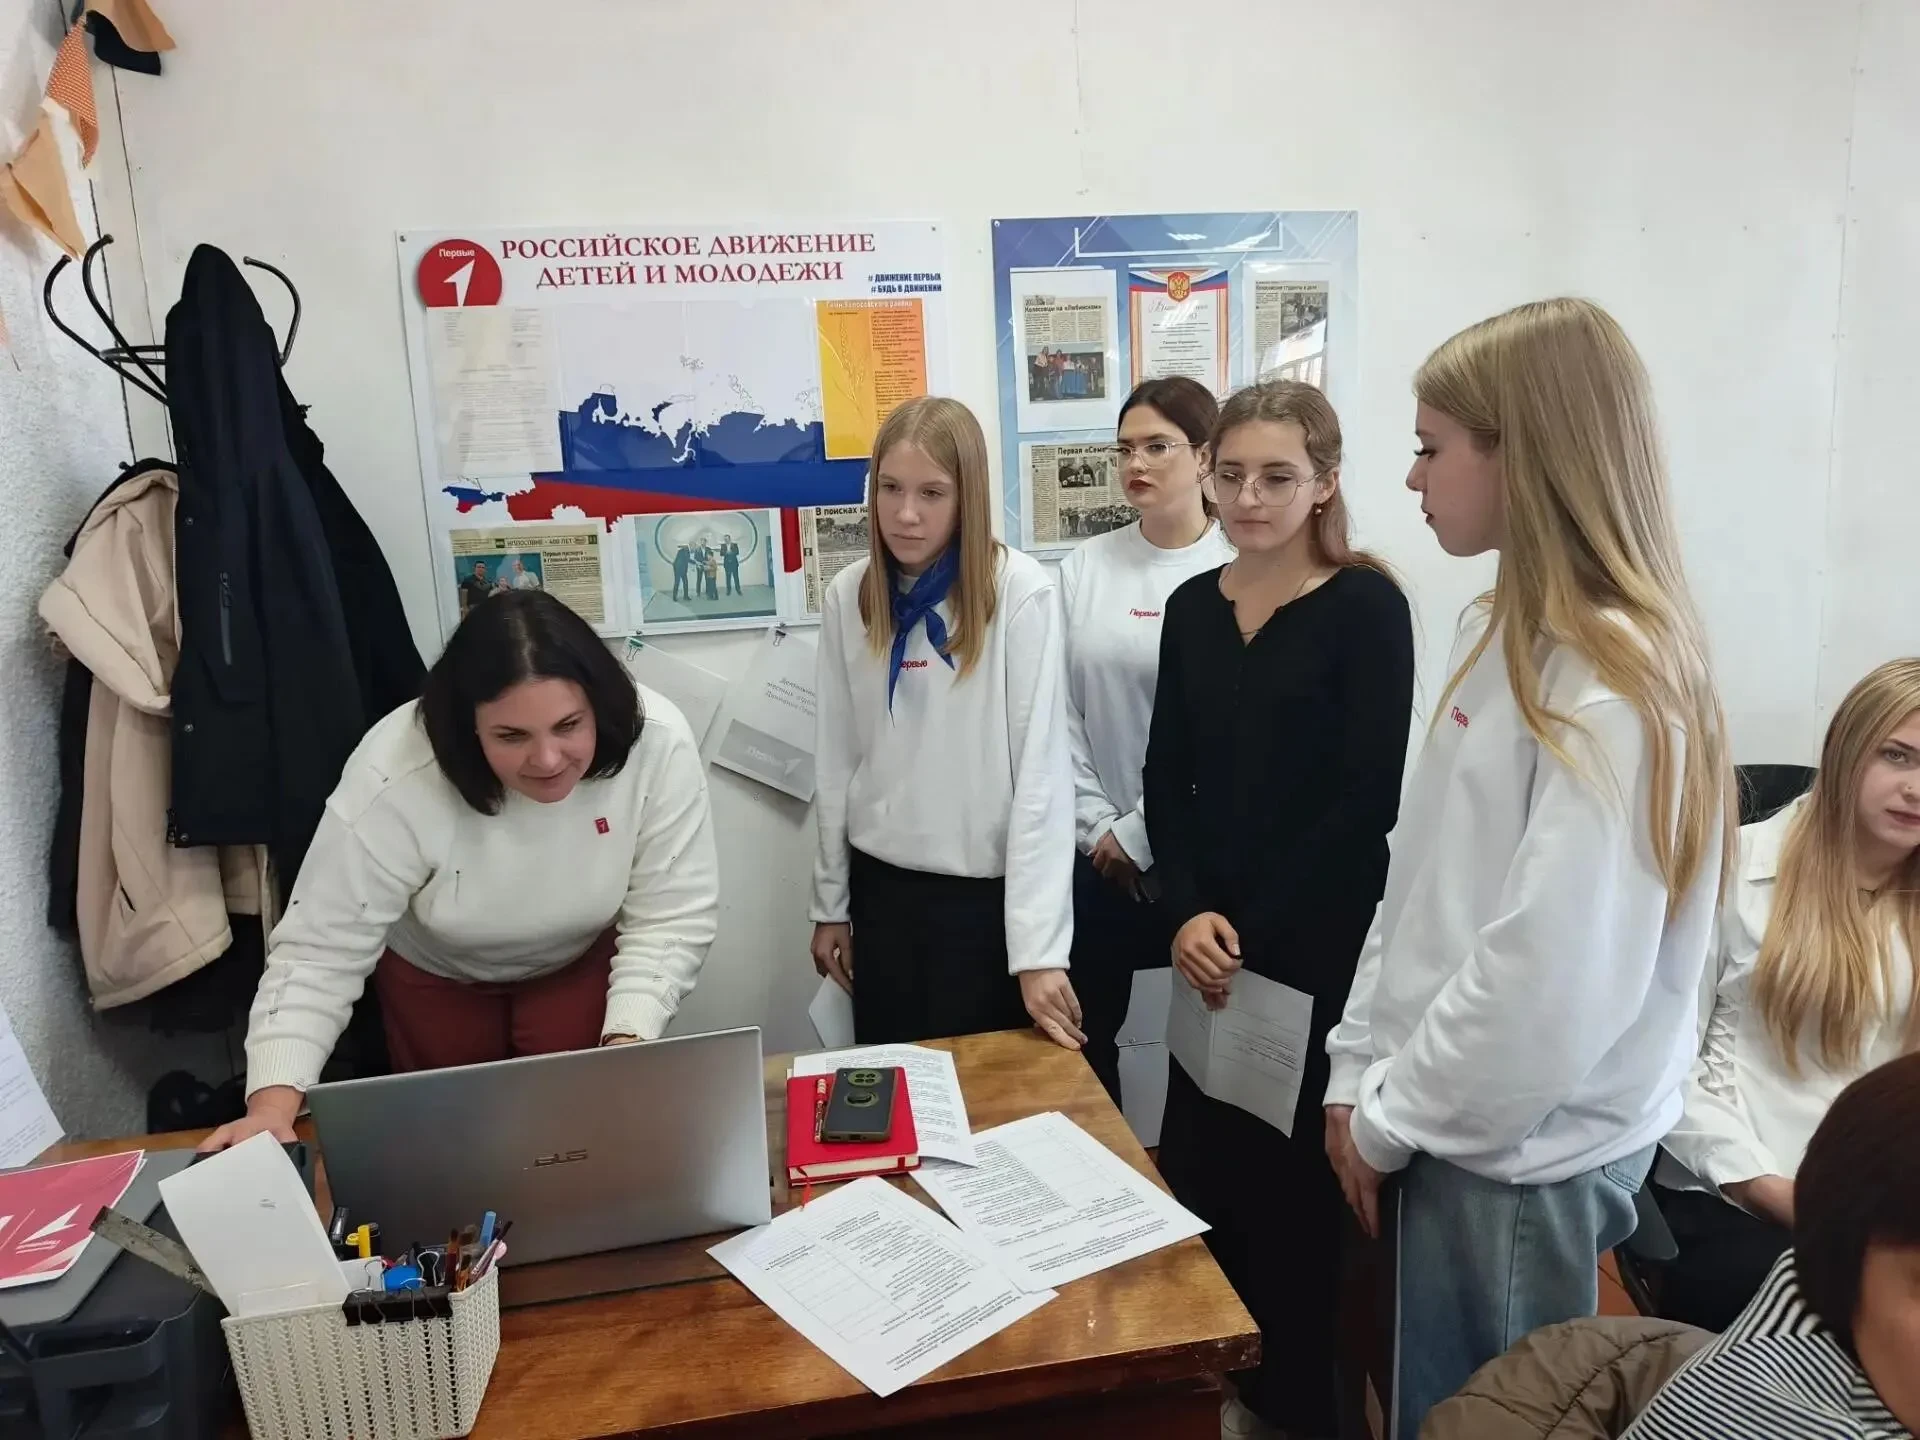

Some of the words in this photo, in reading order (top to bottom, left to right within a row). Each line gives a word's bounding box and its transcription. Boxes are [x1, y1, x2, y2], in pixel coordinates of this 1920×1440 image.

[500, 234, 701, 259] РОССИЙСКОЕ
[708, 233, 875, 258] ДВИЖЕНИЕ
[438, 248, 475, 259] Первые
[536, 261, 637, 289] ДЕТЕЙ
[643, 265, 666, 284] И
[675, 261, 844, 287] МОЛОДЕЖИ
[875, 273, 912, 282] ДВИЖЕНИЕ
[913, 272, 941, 281] ПЕРВЫХ
[877, 284, 897, 293] БУДЬ
[898, 284, 903, 292] В
[904, 284, 942, 293] ДВИЖЕНИИ
[1057, 447, 1083, 456] Первая
[815, 507, 821, 516] В
[823, 507, 858, 515] поисках
[900, 660, 928, 671] ервые
